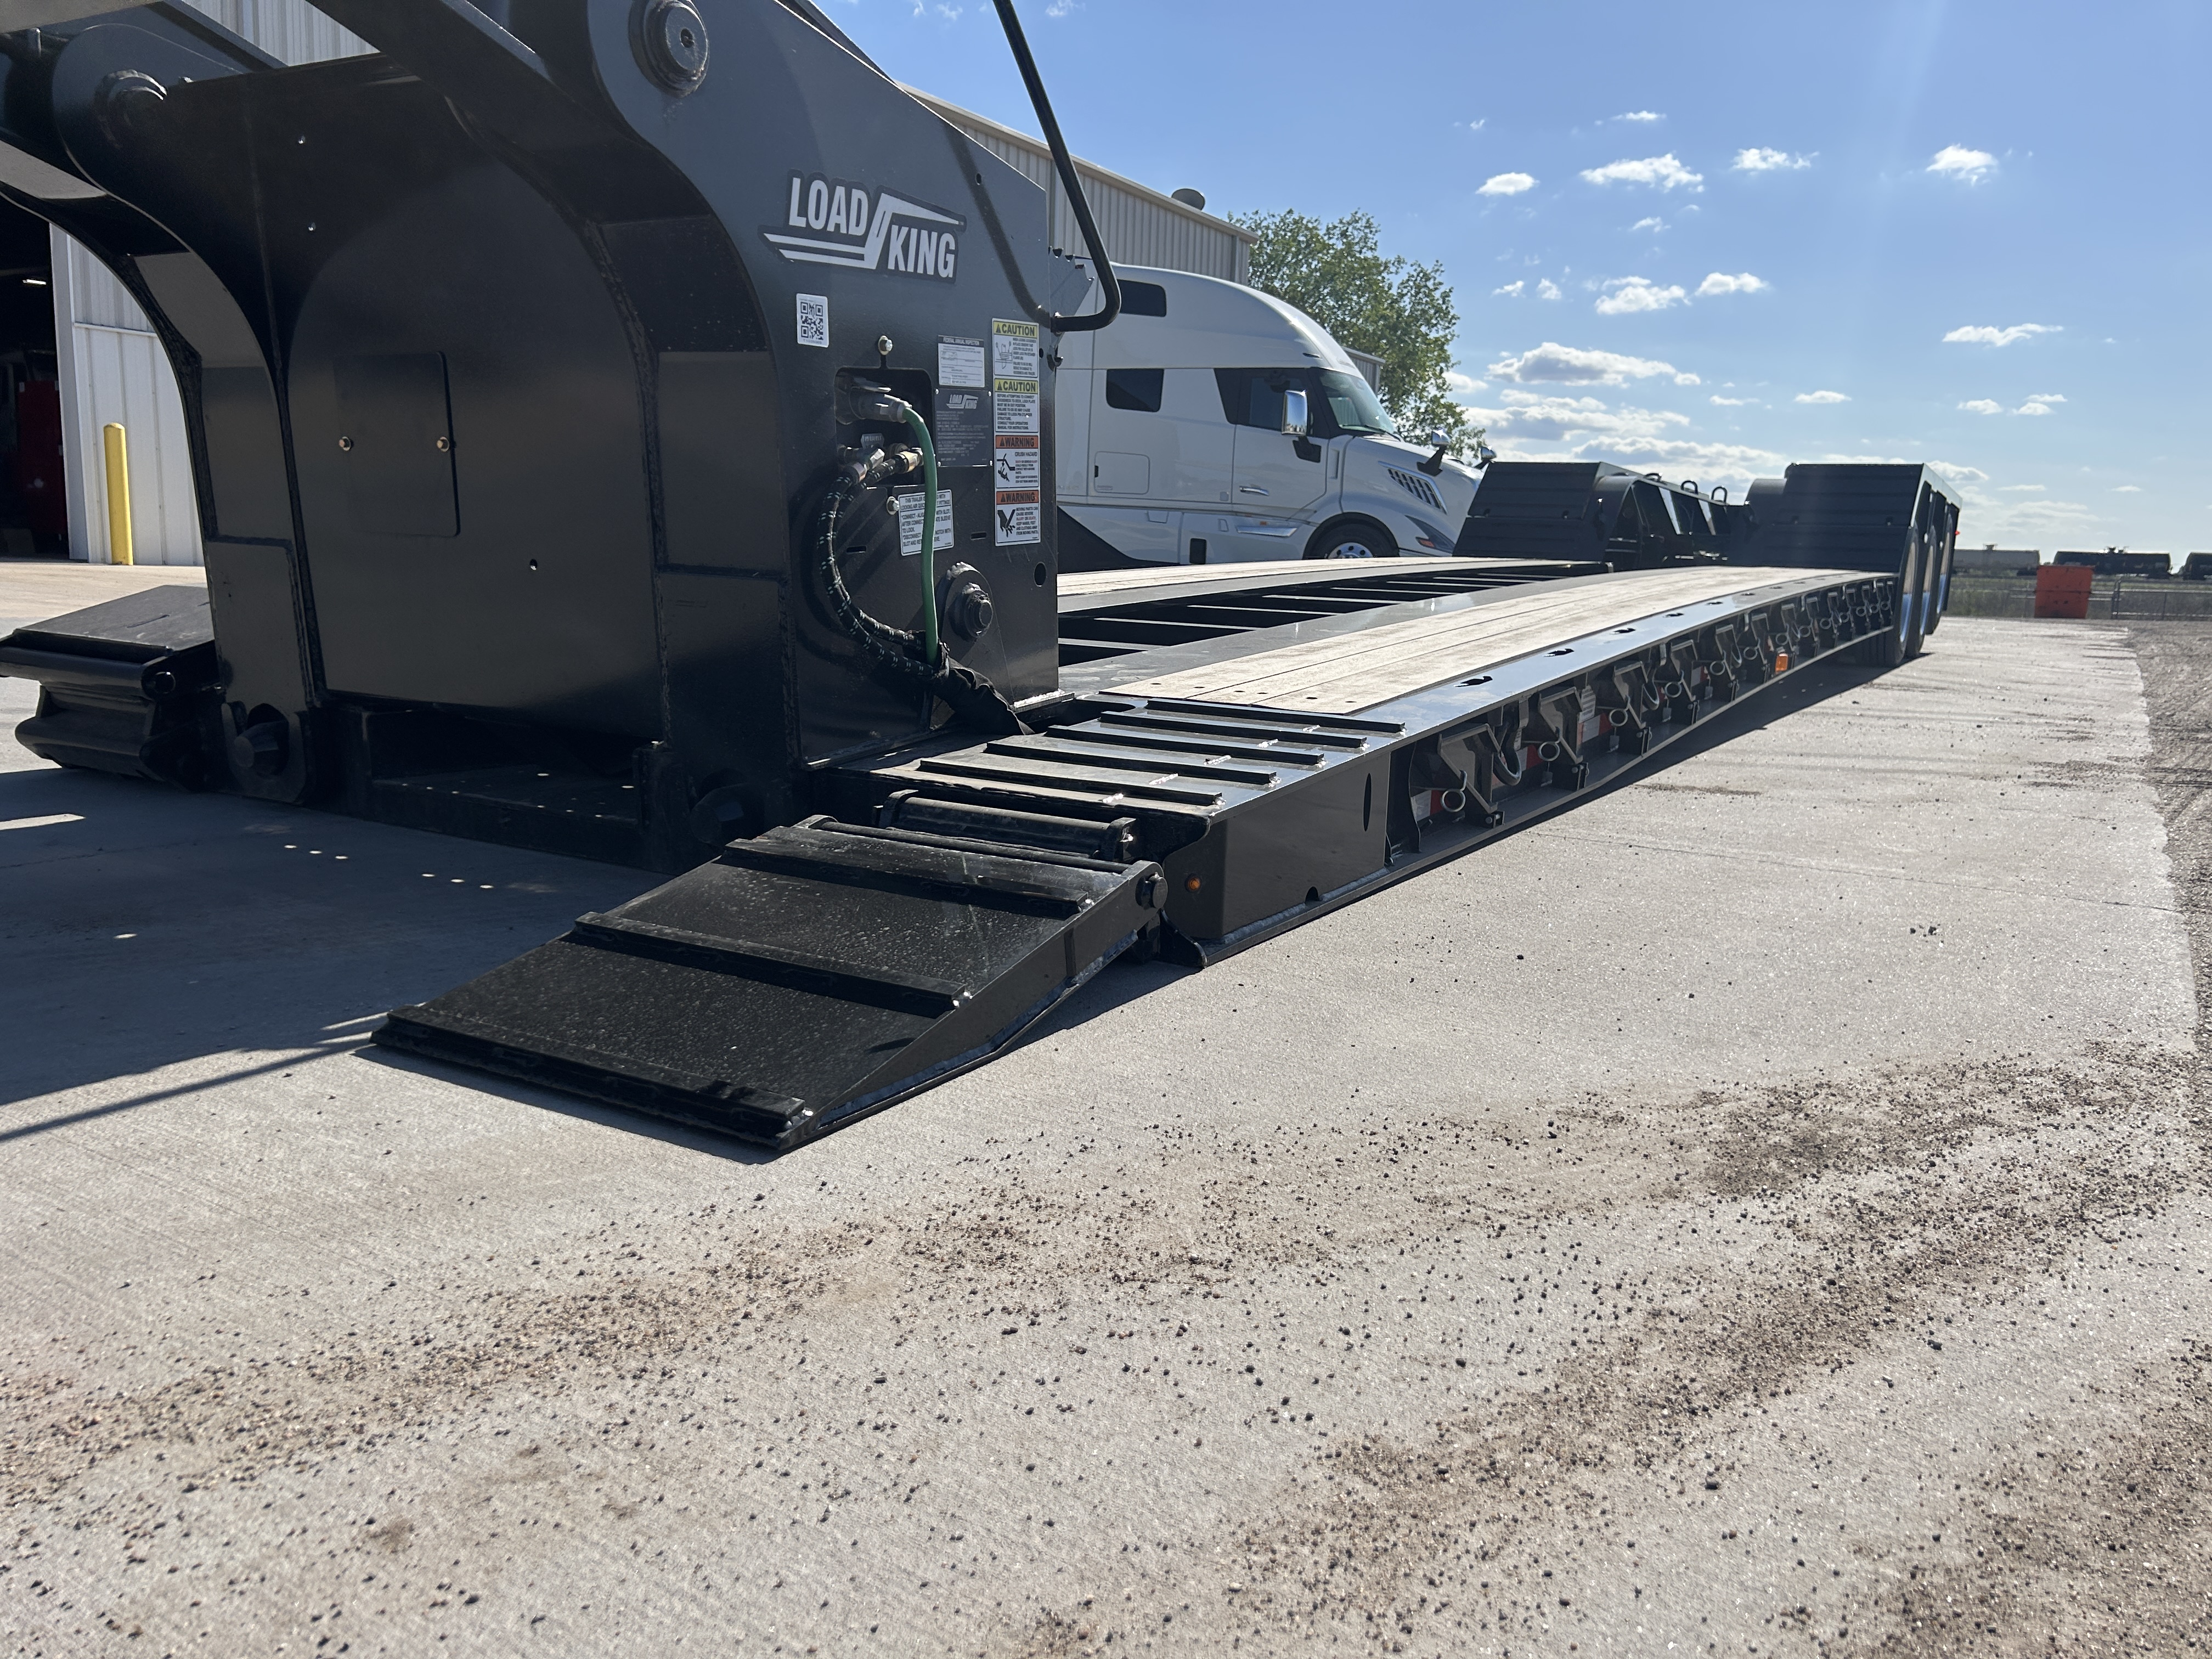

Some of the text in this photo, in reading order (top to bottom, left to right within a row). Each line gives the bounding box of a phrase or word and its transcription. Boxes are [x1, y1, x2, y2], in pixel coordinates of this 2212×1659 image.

[789, 177, 868, 236] LOAD
[888, 224, 956, 278] KING
[1002, 324, 1034, 336] CAUTION
[1003, 381, 1035, 392] CAUTION
[949, 394, 962, 404] LOAD
[965, 399, 977, 409] KING
[1005, 437, 1034, 447] WARNING
[1006, 492, 1035, 502] WARNING
